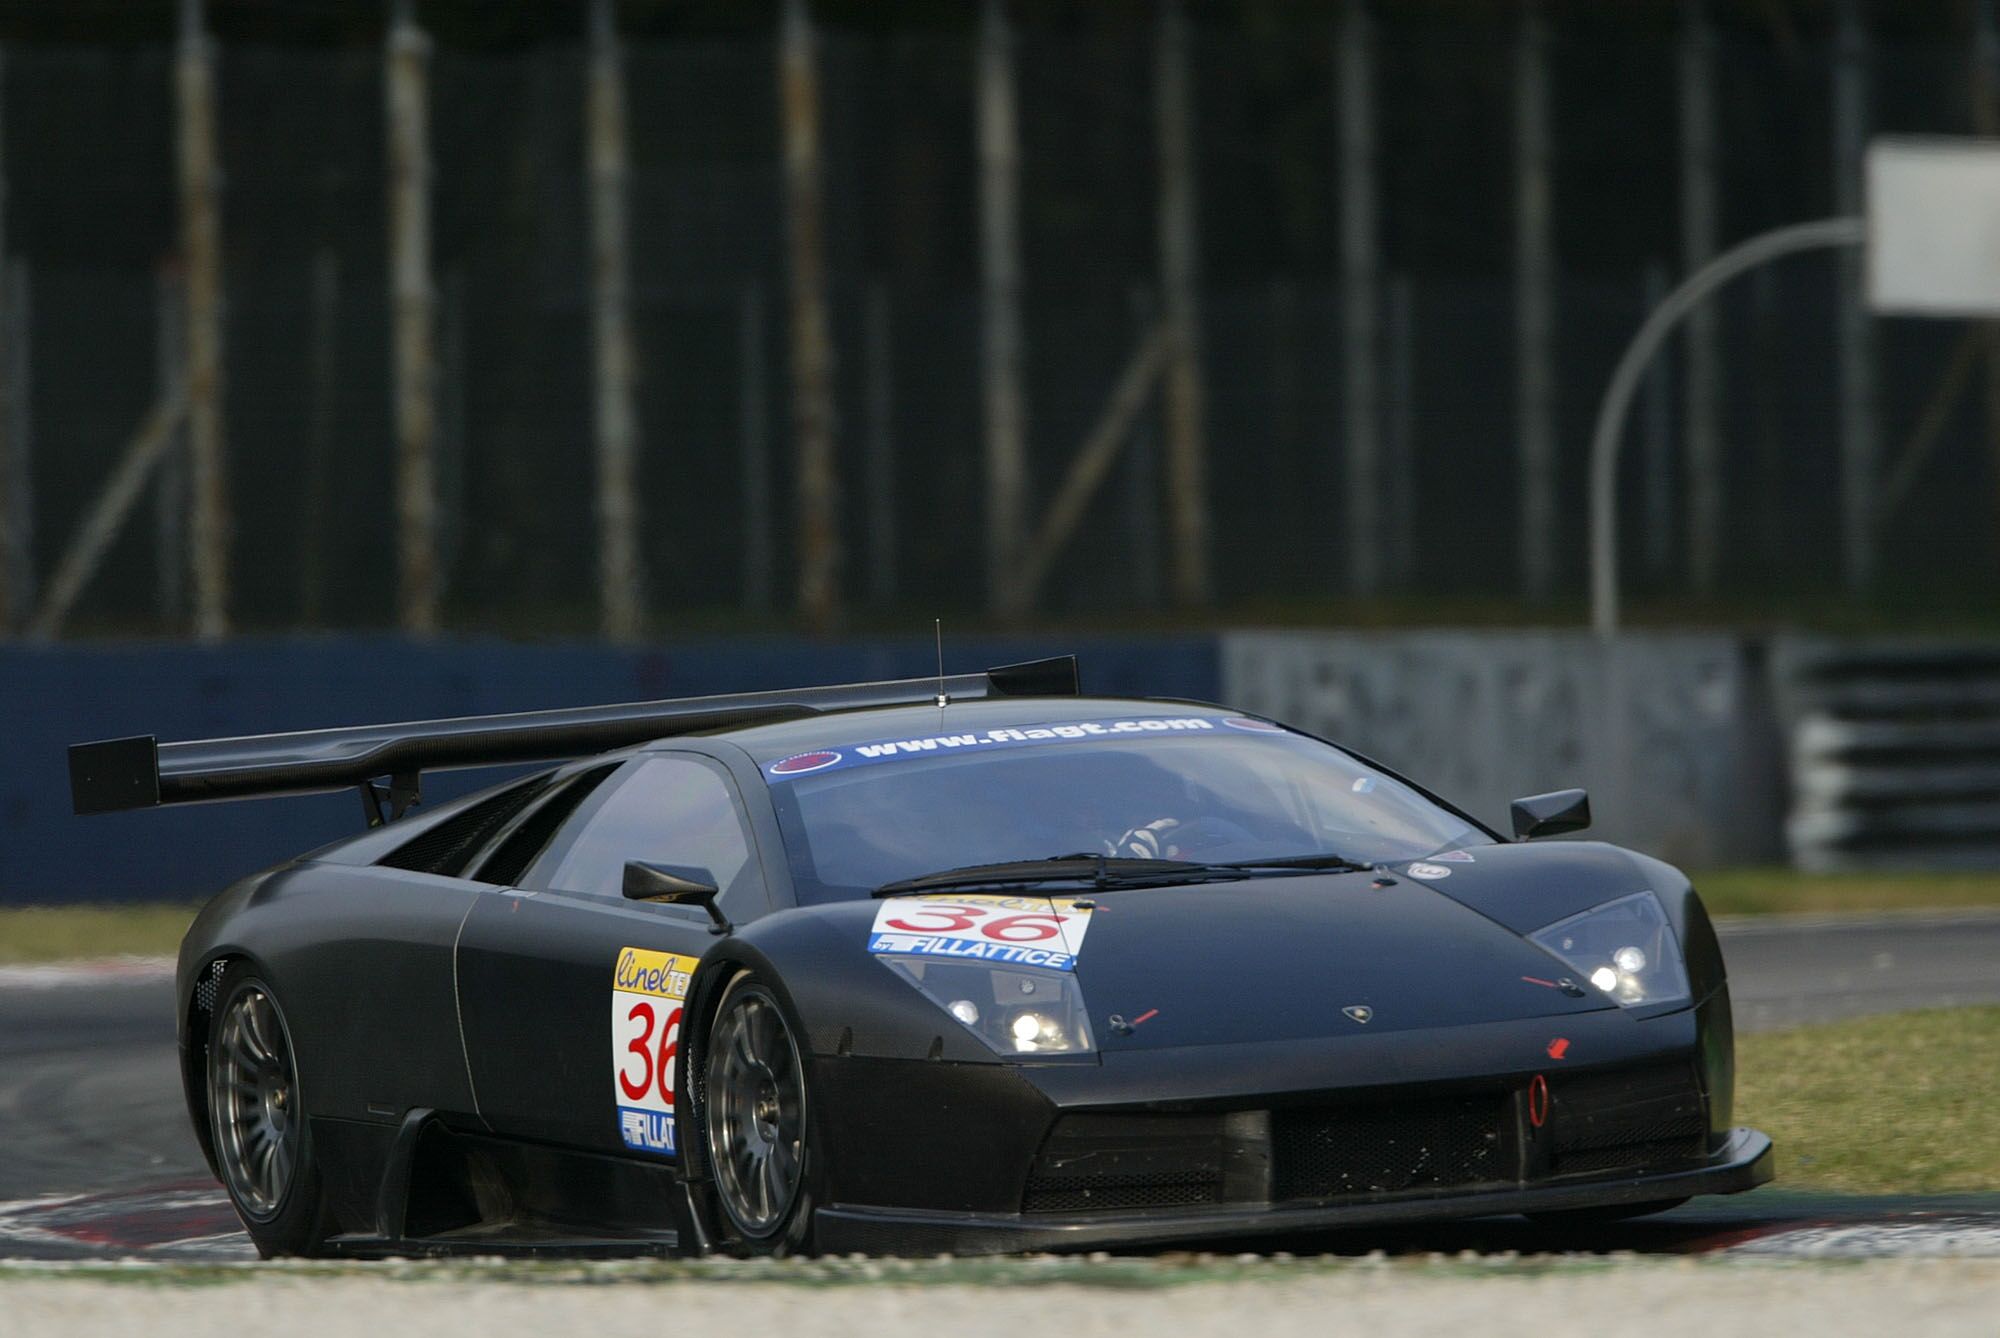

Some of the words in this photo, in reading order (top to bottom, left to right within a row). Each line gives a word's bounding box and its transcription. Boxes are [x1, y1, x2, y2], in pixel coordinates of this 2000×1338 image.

[884, 904, 1071, 942] 36
[907, 934, 1072, 968] FILLATTICE
[619, 1001, 684, 1105] 36
[630, 1112, 675, 1150] FILLAT
